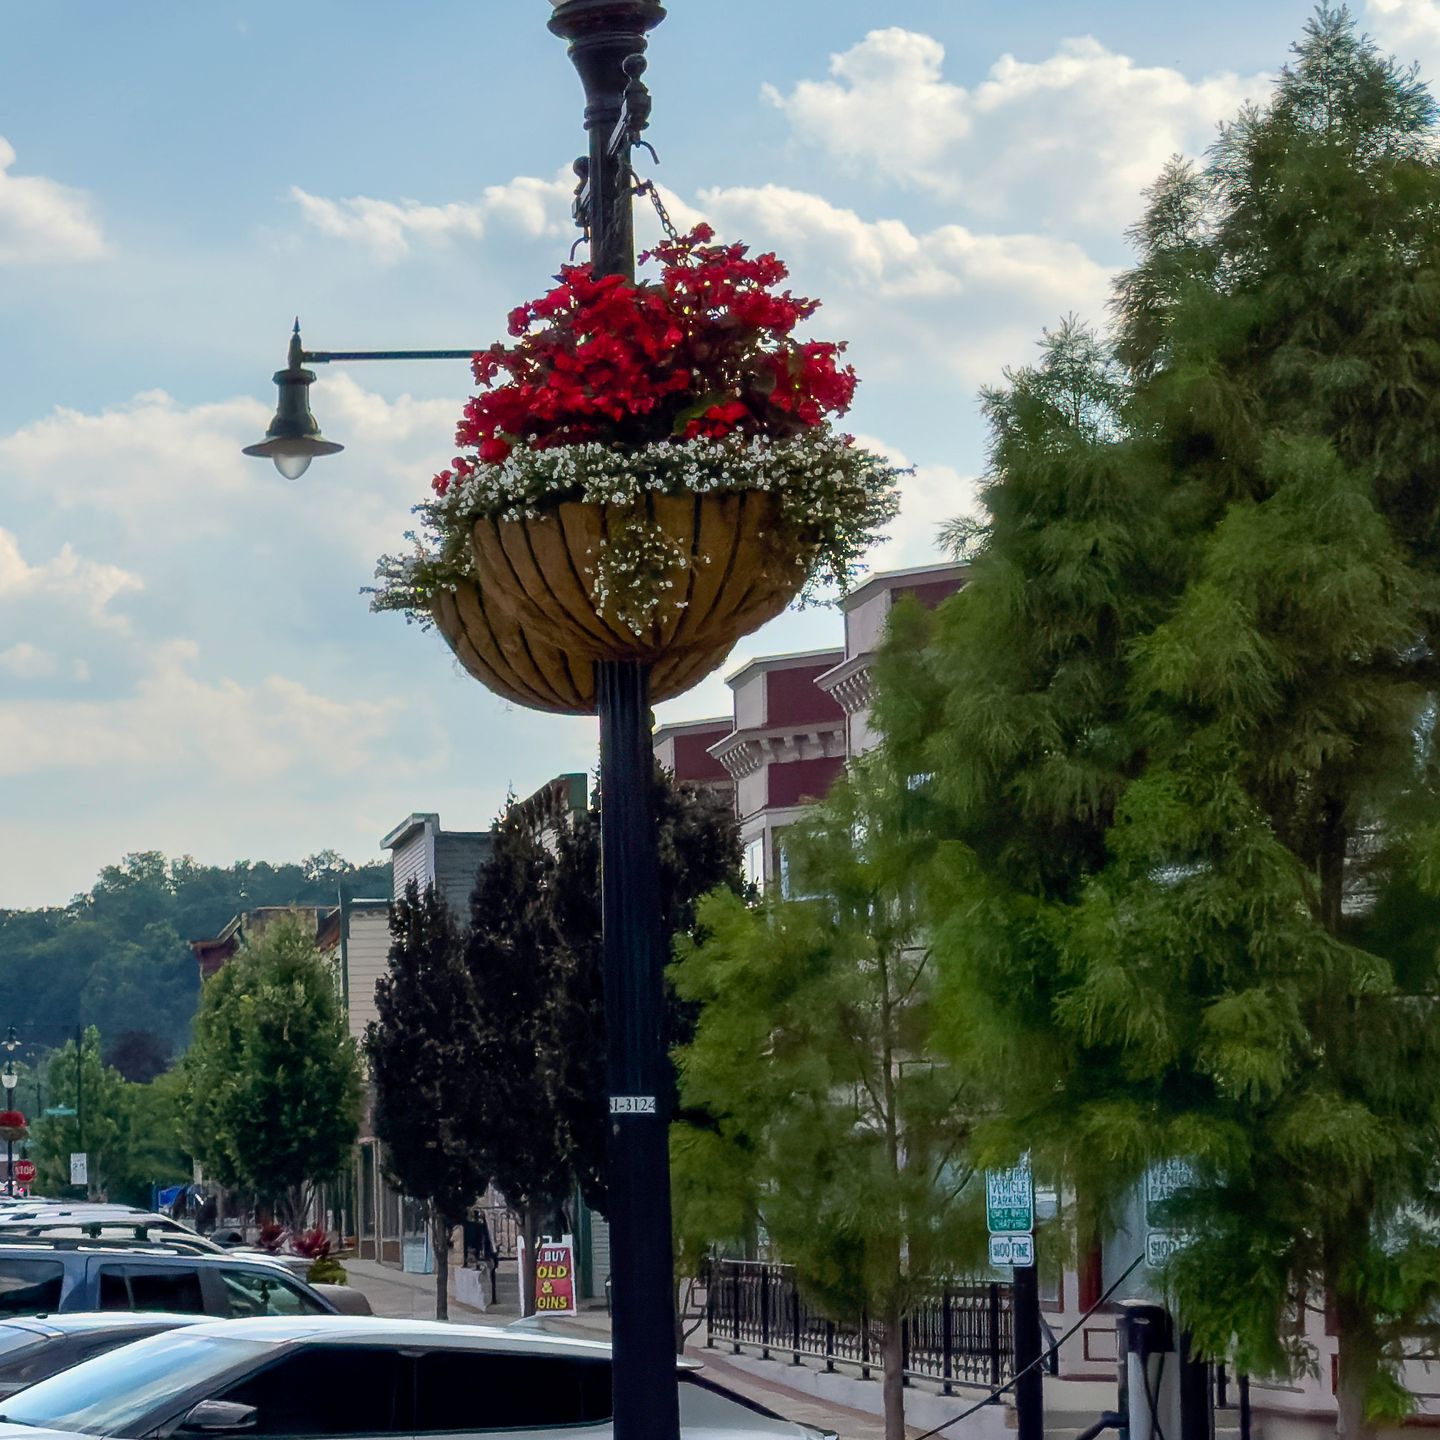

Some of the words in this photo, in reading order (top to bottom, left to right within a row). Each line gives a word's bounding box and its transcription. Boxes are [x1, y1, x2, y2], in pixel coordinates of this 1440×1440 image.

[15, 1165, 35, 1175] STOP
[991, 1181, 1027, 1194] VEHICLE
[992, 1195, 1028, 1207] PARKING
[544, 1250, 566, 1262] BUY
[1011, 1243, 1029, 1257] FINE
[536, 1265, 567, 1279] OLD
[541, 1280, 553, 1294] &
[536, 1296, 567, 1309] OINS
